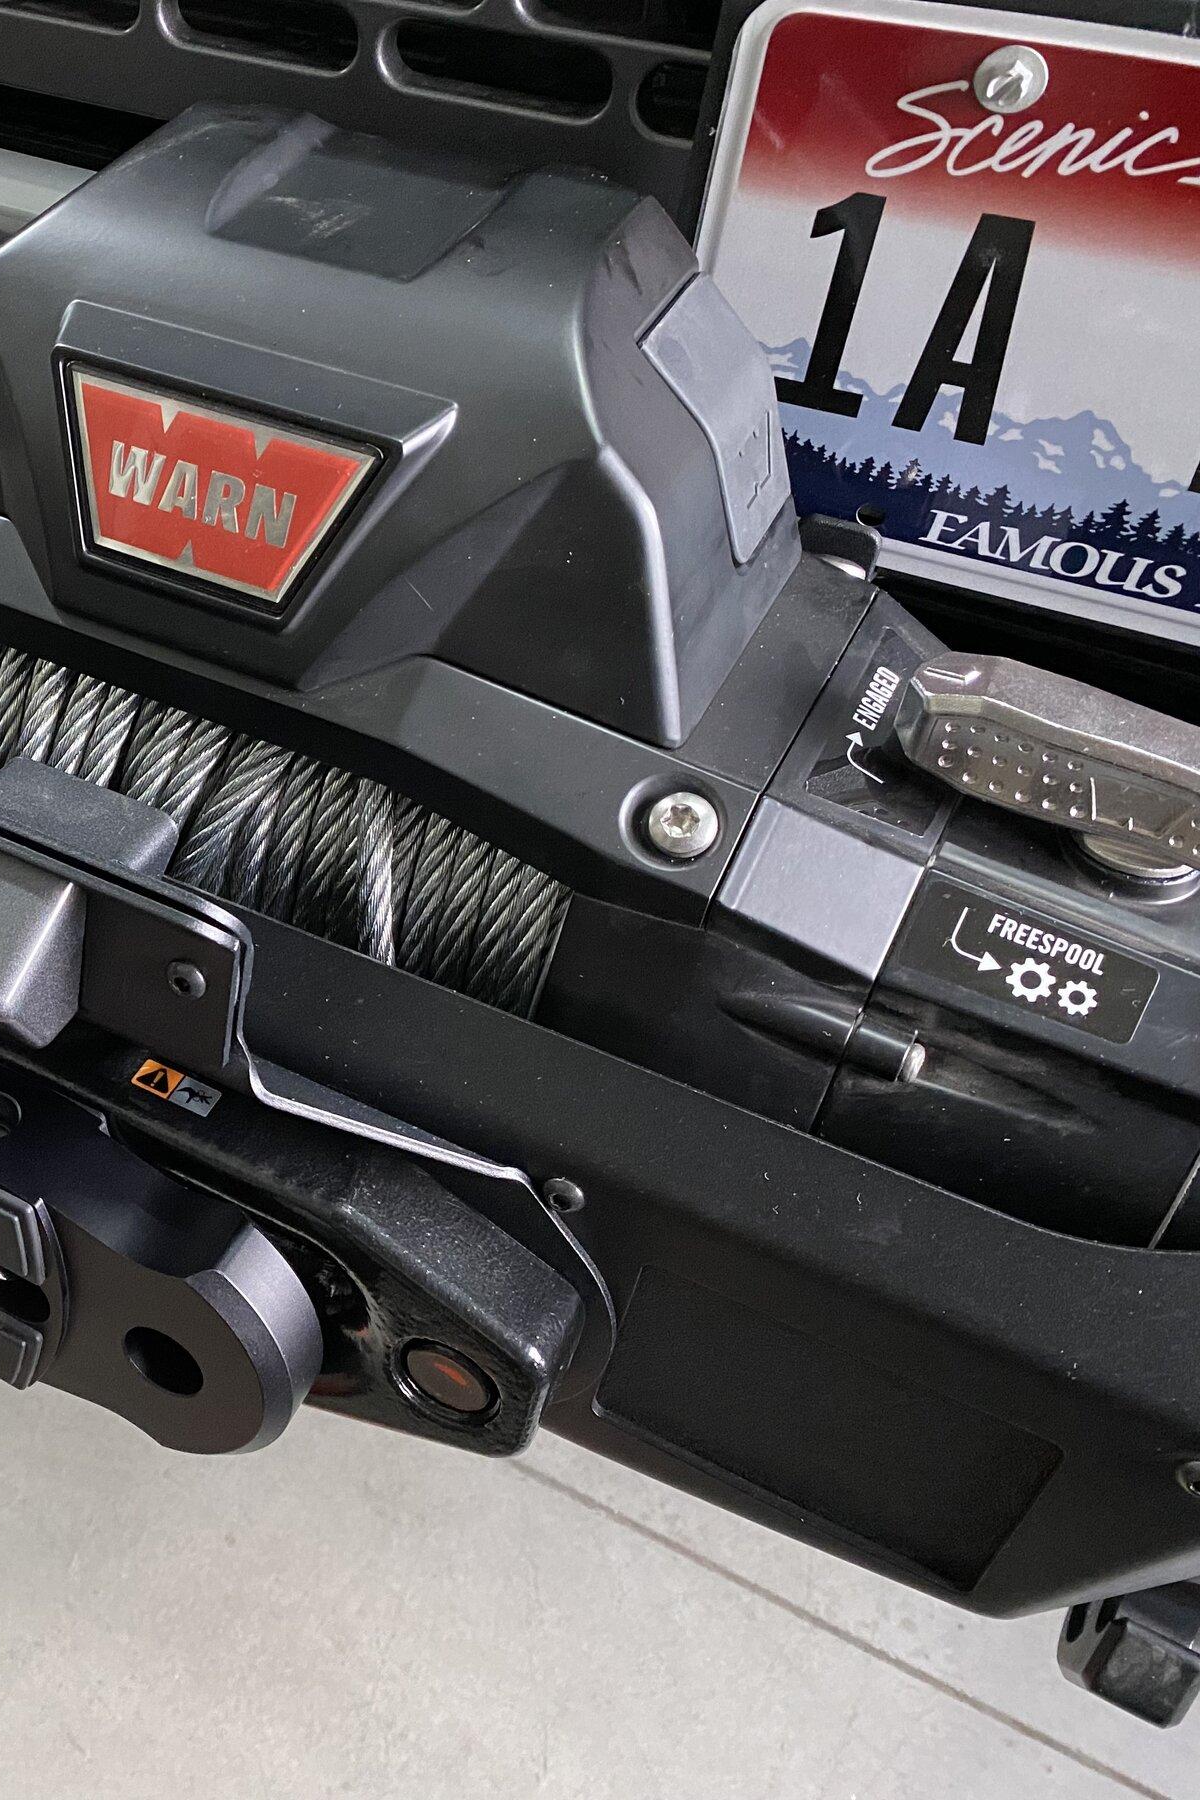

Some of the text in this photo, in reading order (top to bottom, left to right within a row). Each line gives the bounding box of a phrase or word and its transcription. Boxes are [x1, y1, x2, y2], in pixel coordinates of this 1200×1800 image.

[865, 79, 1200, 179] Scenic
[108, 439, 298, 549] WARN
[923, 509, 1188, 599] FAMOUS
[852, 665, 901, 732] ENGAGED
[987, 912, 1105, 977] FREESPOOL
